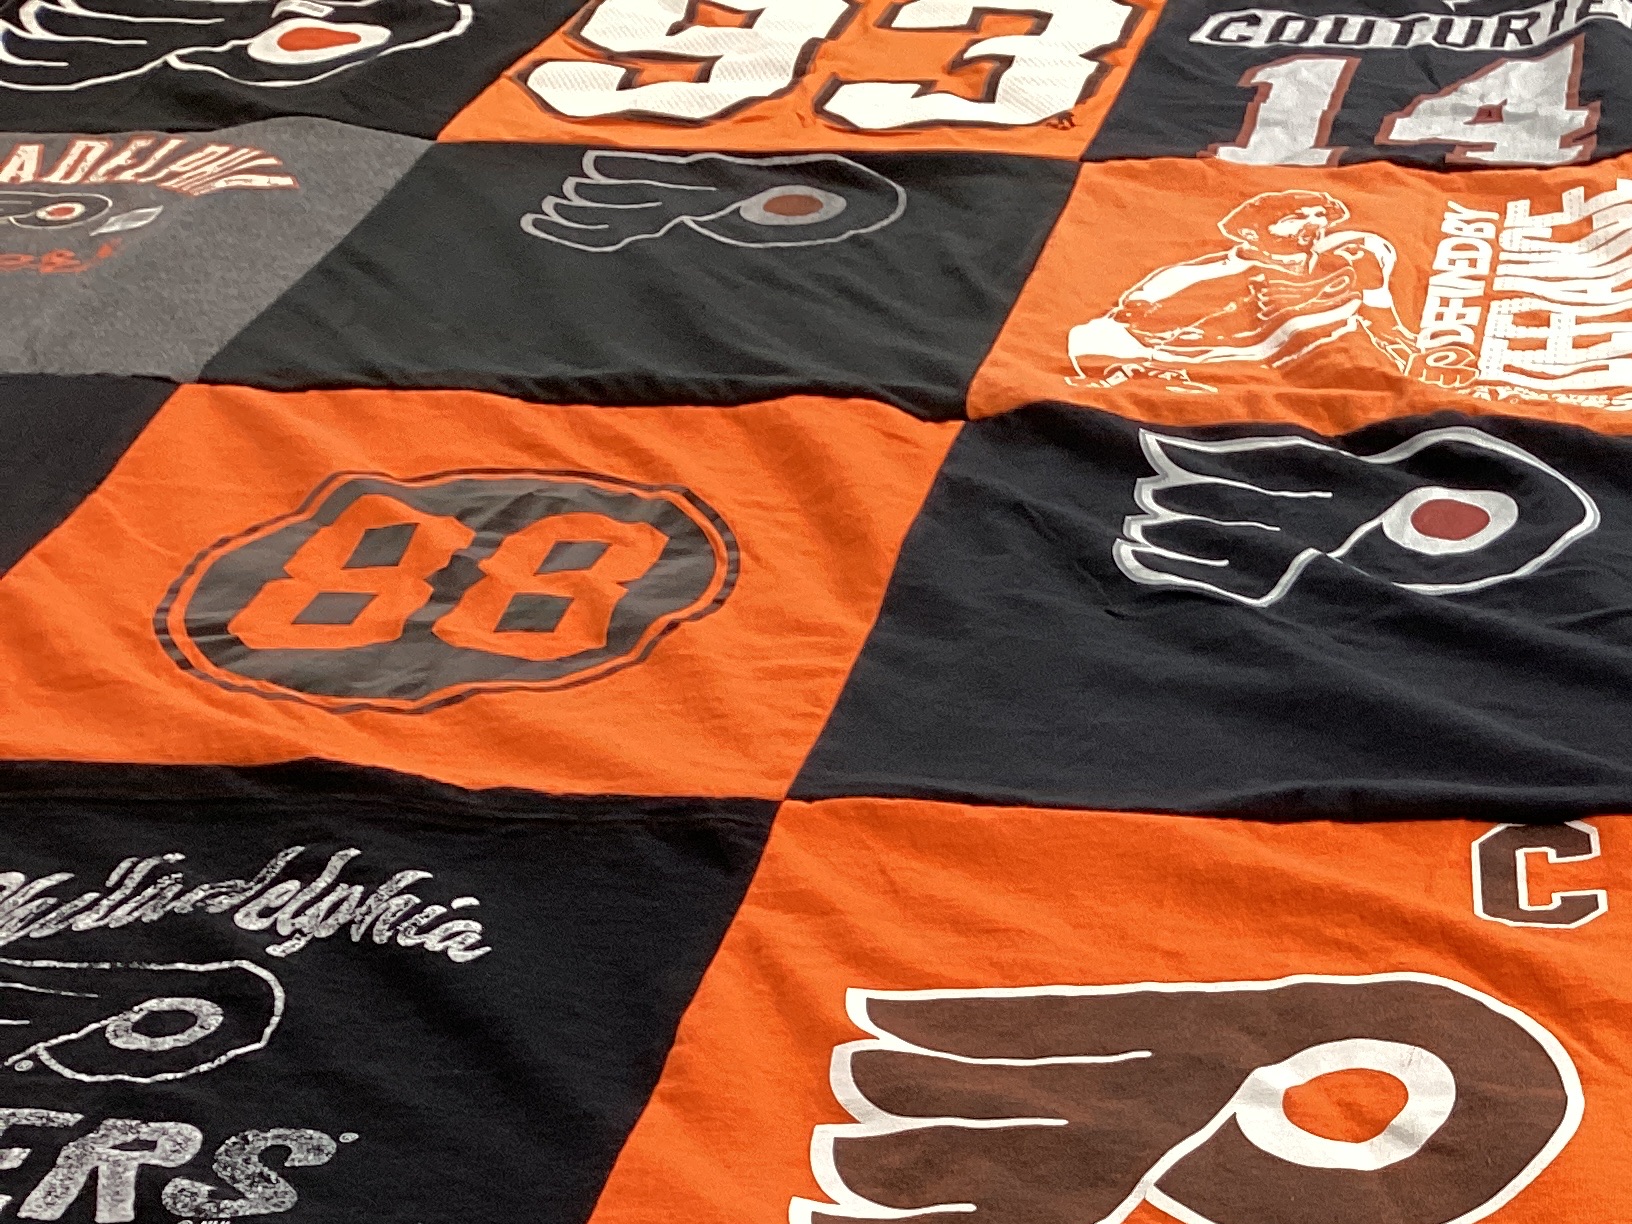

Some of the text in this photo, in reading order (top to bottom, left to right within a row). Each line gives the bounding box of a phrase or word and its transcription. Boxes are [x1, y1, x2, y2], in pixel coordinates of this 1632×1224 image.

[503, 0, 1144, 131] 93
[1197, 33, 1600, 167] 14
[1415, 200, 1500, 355] DEFINED BY
[226, 493, 671, 662] 88
[1471, 820, 1610, 929] C
